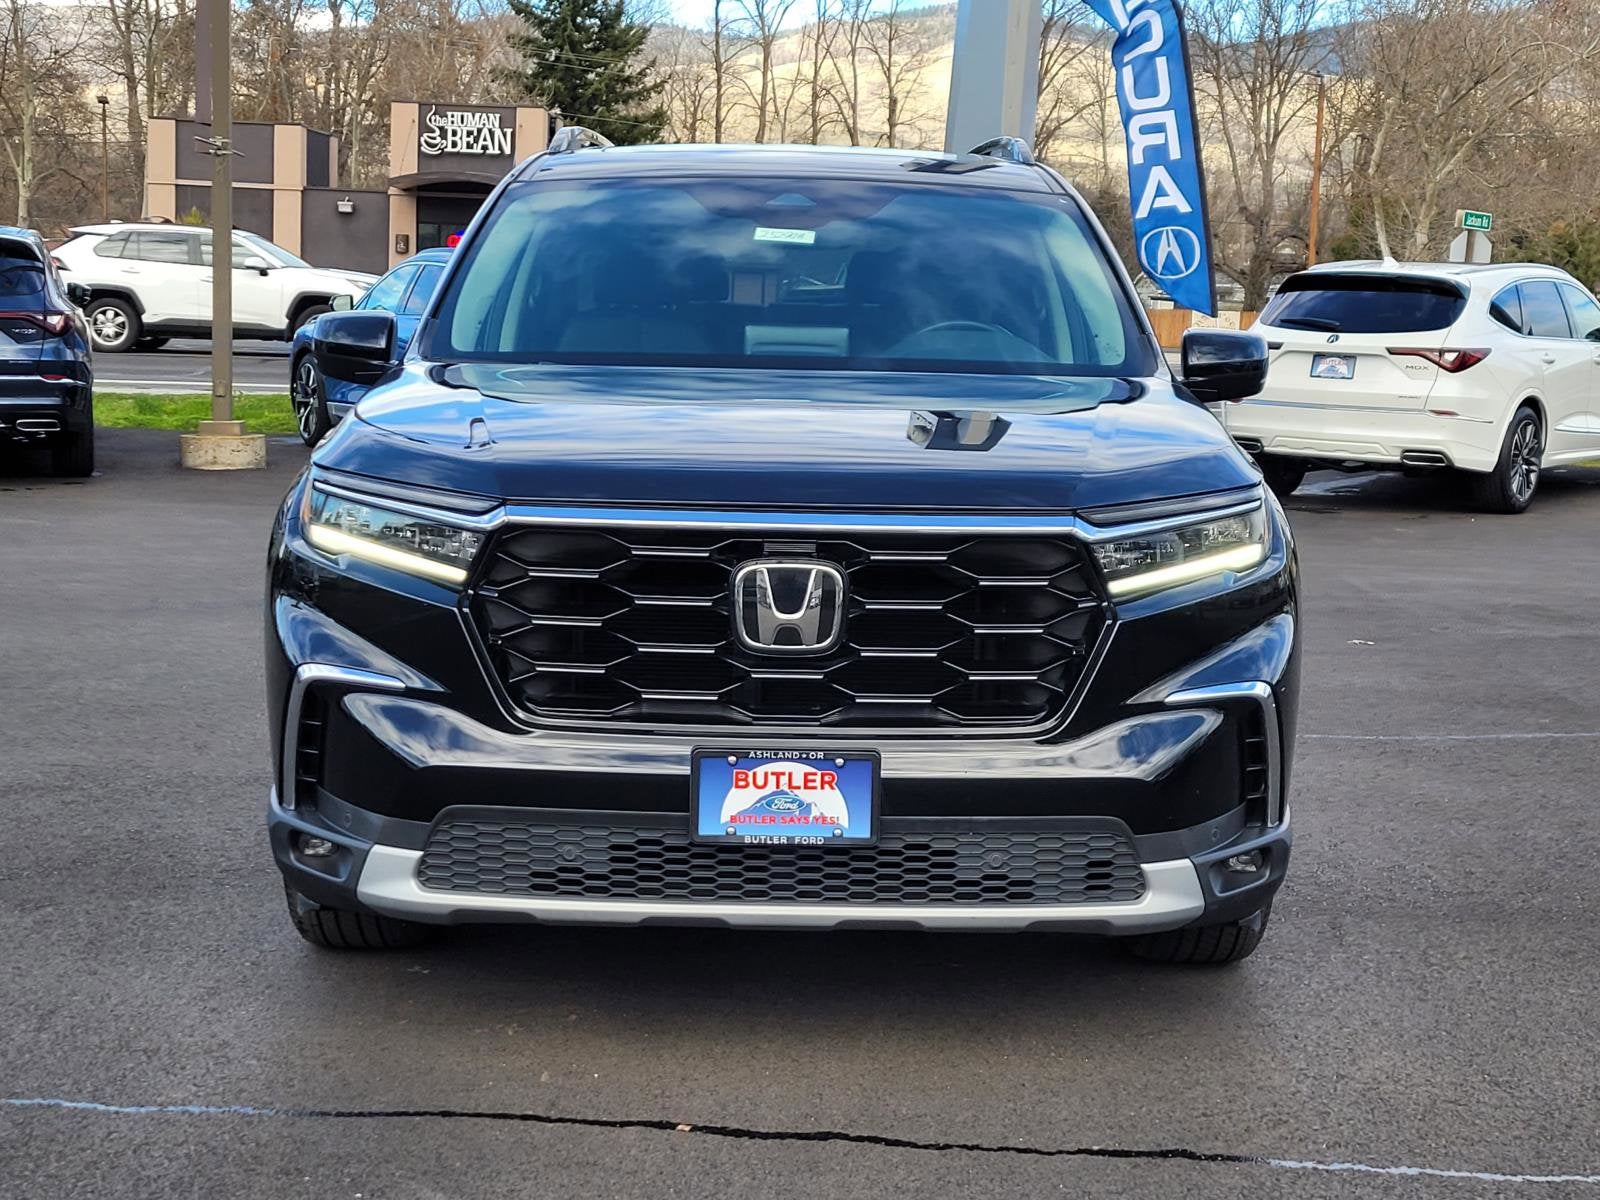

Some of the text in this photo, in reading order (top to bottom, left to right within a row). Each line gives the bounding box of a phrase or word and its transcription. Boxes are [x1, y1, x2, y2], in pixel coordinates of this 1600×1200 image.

[431, 111, 501, 129] the HUMAN
[444, 127, 513, 154] BEAN
[748, 750, 825, 760] ASHLAND OR
[733, 770, 837, 791] BUTLER
[771, 797, 800, 811] Ford
[729, 814, 840, 826] BUTLER SAYS YES!
[744, 835, 825, 846] BUTLER FORD
